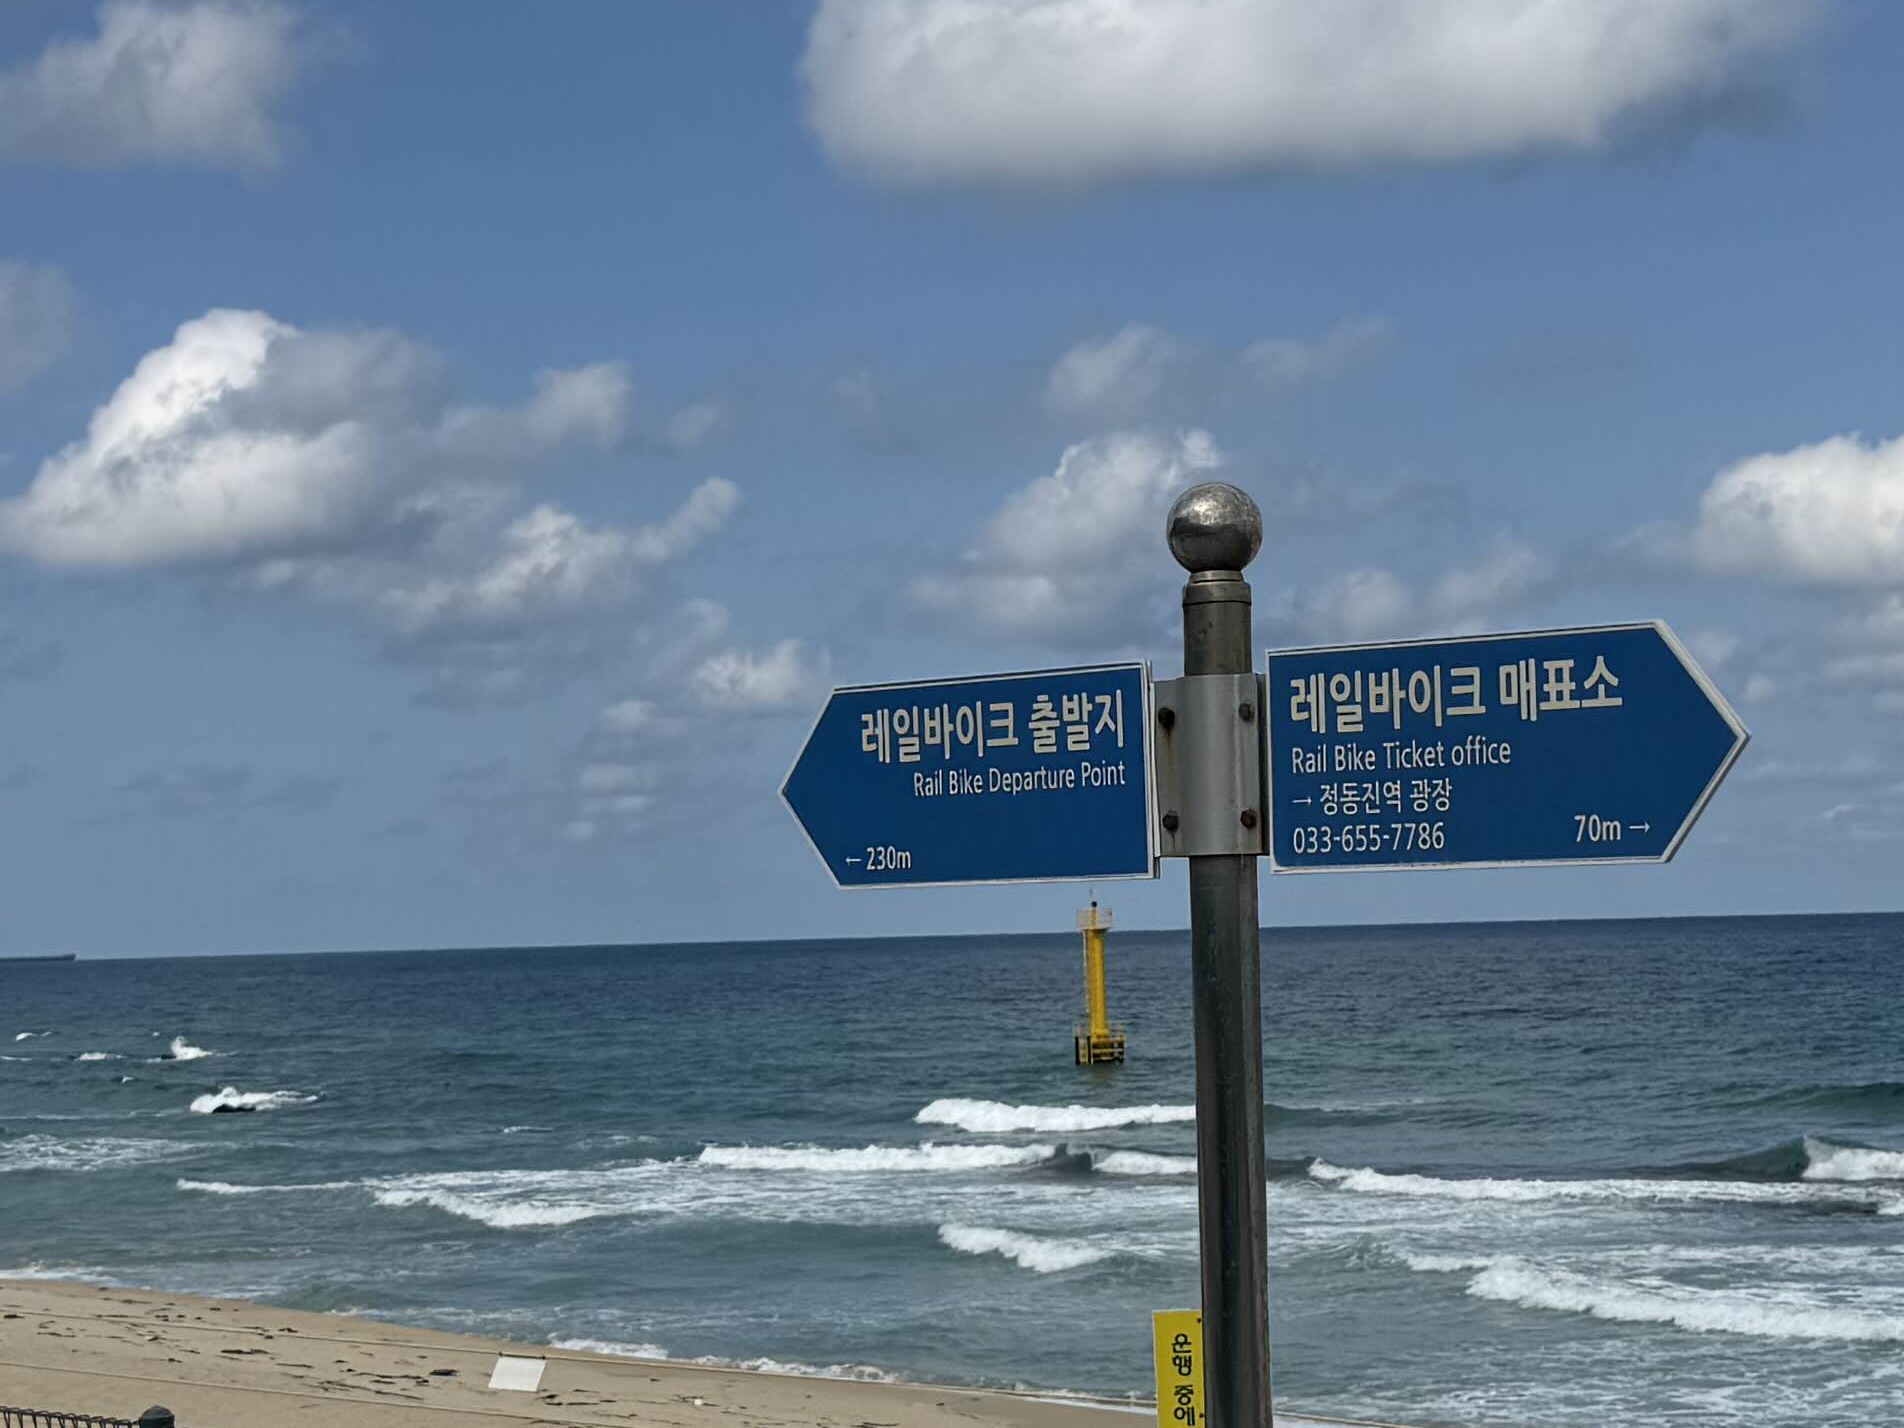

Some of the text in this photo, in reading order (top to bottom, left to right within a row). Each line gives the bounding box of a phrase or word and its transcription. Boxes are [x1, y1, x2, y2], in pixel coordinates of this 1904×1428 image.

[1289, 655, 1624, 734] 레일바이크 매표소
[861, 689, 1125, 764] 레일바이크 출발지
[1291, 734, 1512, 774] Rail Bike Ticket office
[913, 759, 1126, 797] Rail Bike Departure Point
[1319, 777, 1453, 816] 정동진역 광장
[1292, 821, 1446, 854] 033-655-7786
[1574, 814, 1622, 844] 70m
[865, 845, 912, 871] 230m
[1171, 1332, 1193, 1376] 운행
